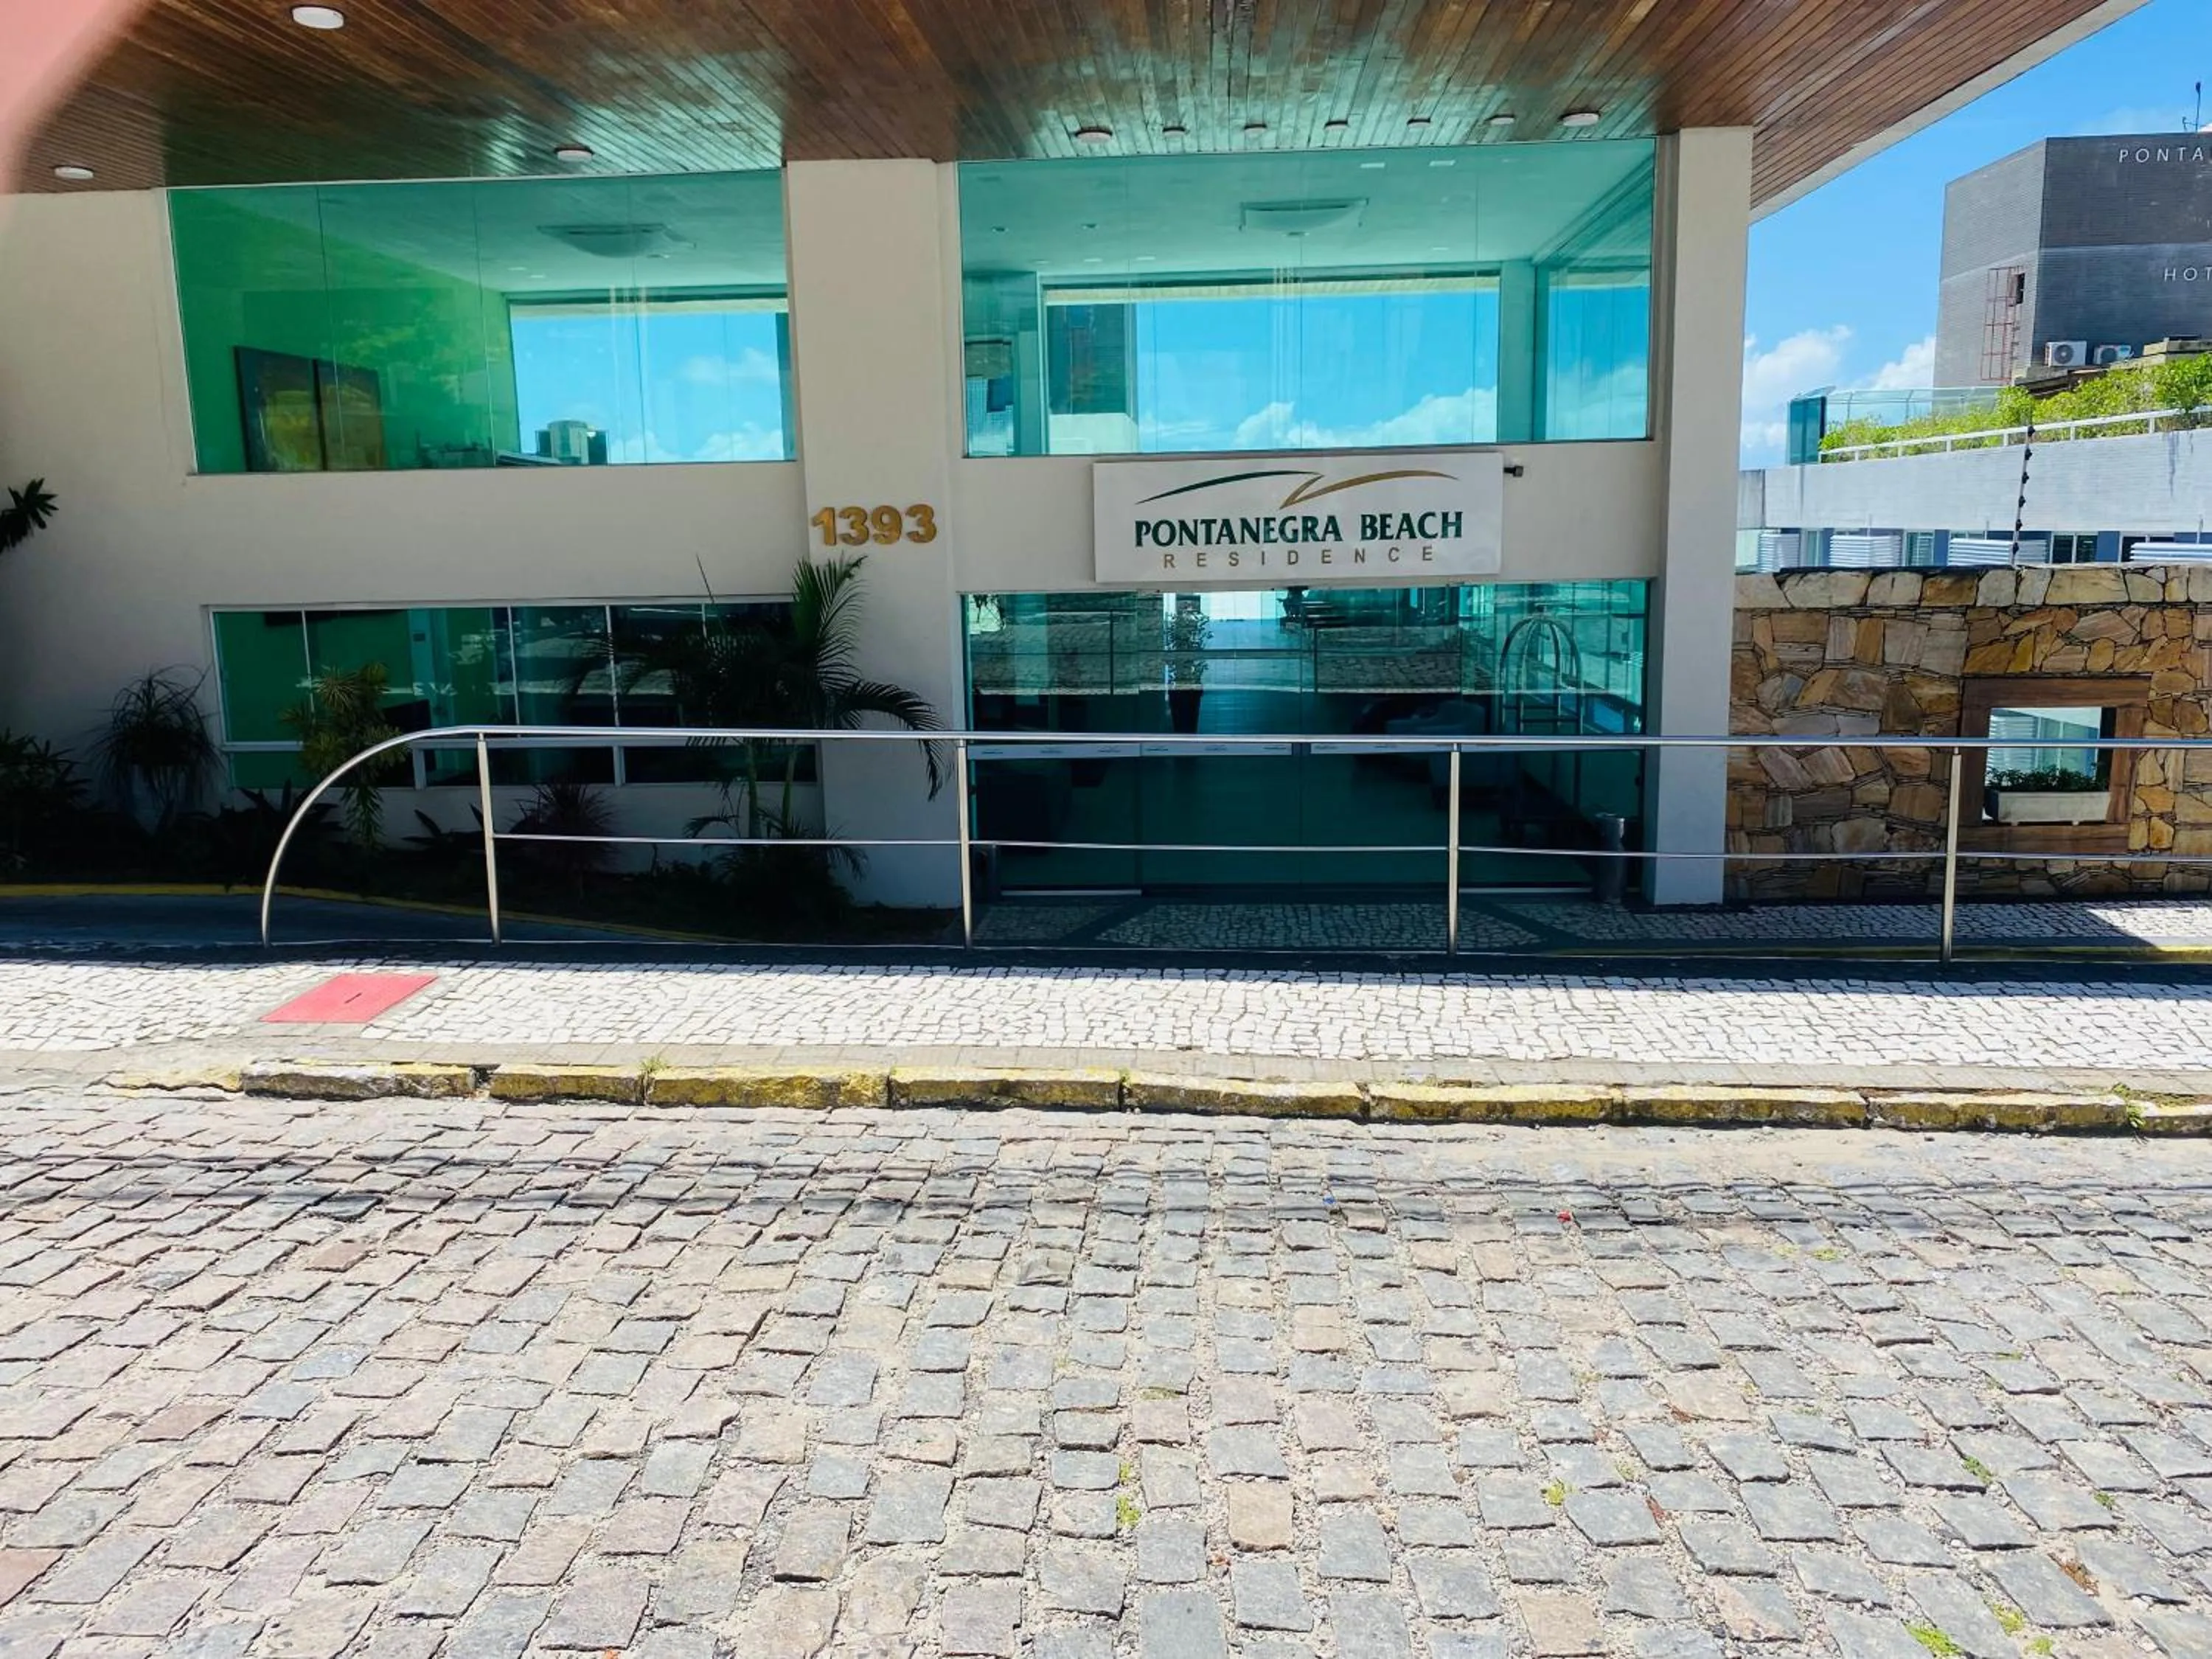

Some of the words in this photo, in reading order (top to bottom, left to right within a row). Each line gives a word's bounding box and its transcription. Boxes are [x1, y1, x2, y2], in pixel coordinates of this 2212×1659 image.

[2118, 147, 2204, 163] PONTA
[2164, 266, 2212, 282] HOT
[812, 504, 937, 546] 1393
[1135, 515, 1343, 547] PONTANEGRA
[1360, 511, 1464, 540] BEACH
[1164, 545, 1434, 568] RESIDENCE
